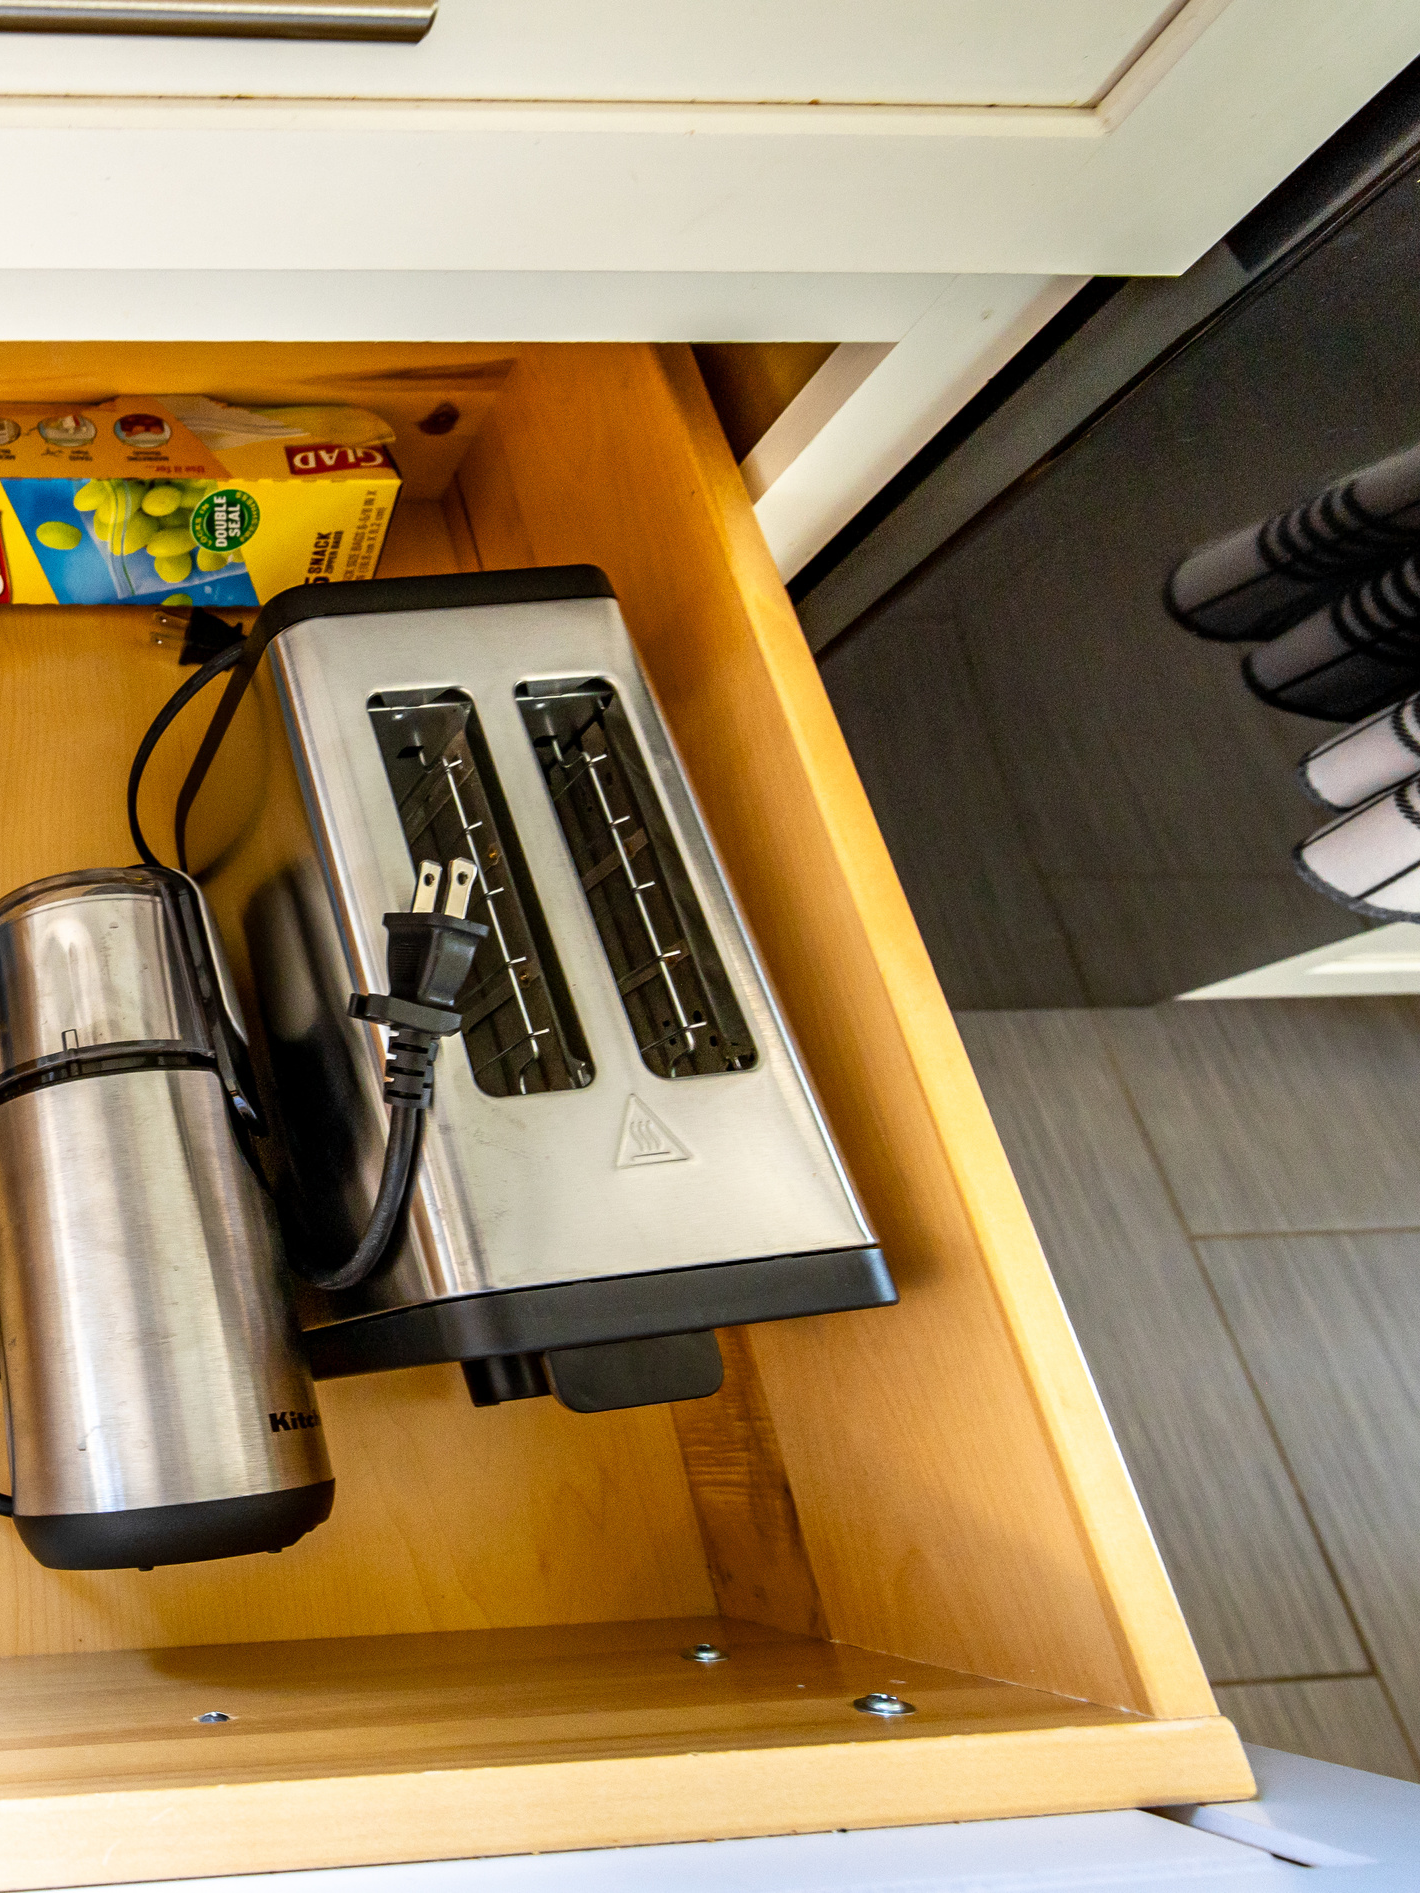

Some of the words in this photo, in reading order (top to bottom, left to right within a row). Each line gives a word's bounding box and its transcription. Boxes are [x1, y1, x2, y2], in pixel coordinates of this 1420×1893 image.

[293, 447, 383, 469] GLAD
[213, 495, 228, 547] DOUBLE
[227, 503, 241, 537] SEAL
[307, 532, 332, 574] SNACK
